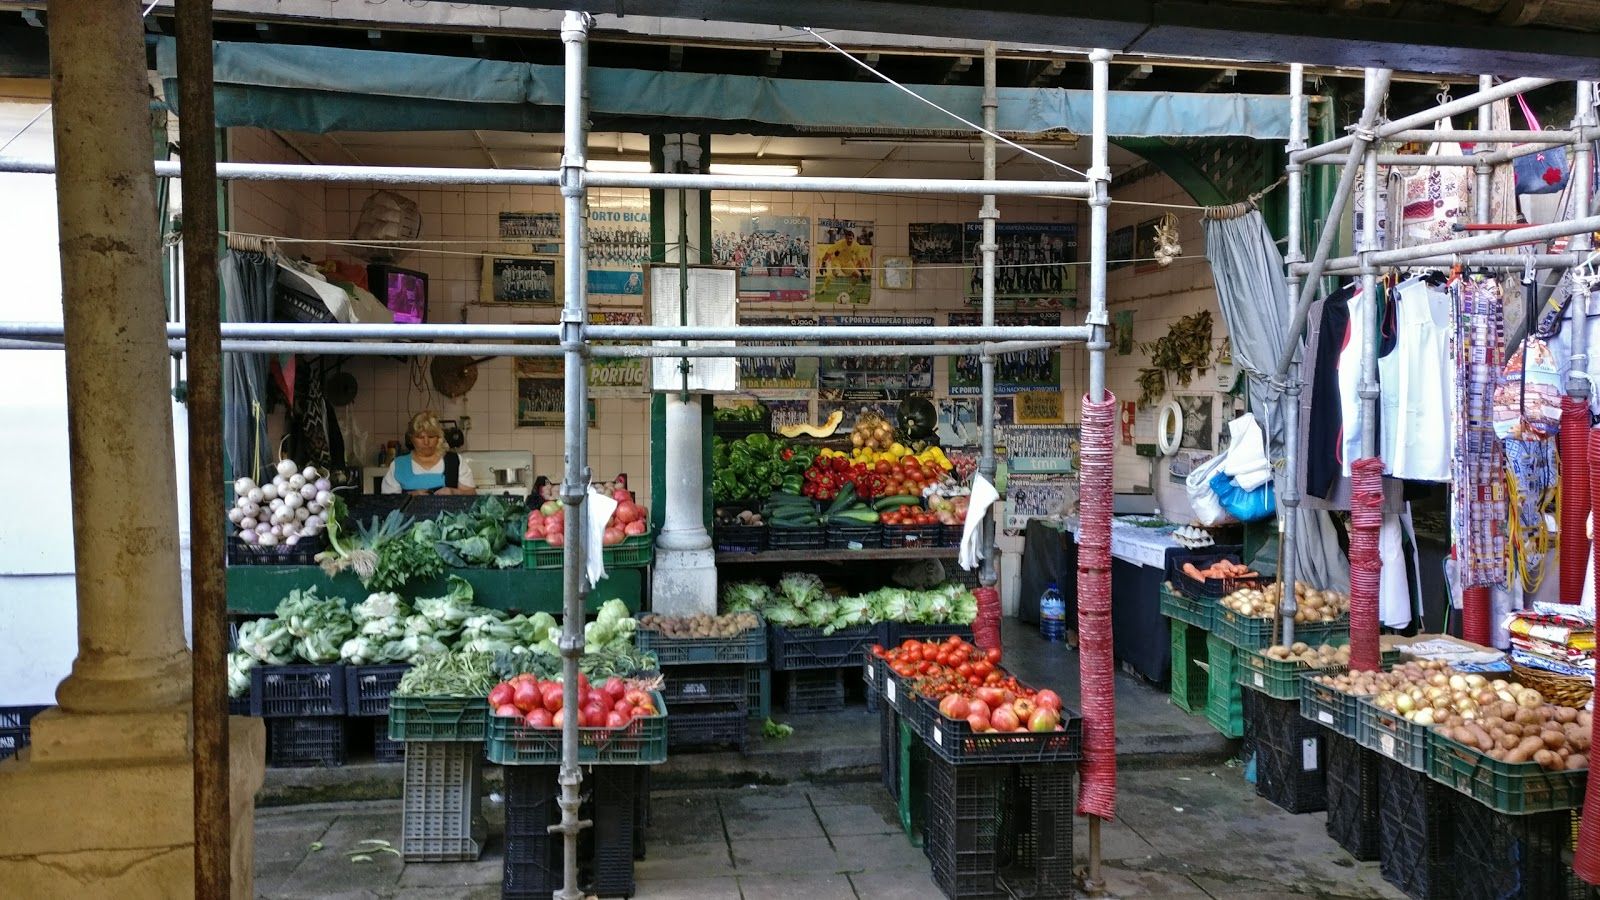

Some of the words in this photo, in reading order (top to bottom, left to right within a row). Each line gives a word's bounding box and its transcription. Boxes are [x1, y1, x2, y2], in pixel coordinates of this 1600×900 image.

[587, 211, 621, 221] ORTO
[967, 223, 974, 231] FC
[871, 316, 901, 325] CAMPEÃO
[902, 317, 932, 325] EUROPEU
[749, 380, 760, 388] DA
[761, 379, 779, 388] LIGA
[782, 379, 811, 388] EUROPA
[951, 386, 959, 394] FC
[960, 386, 980, 394] PORTO
[1031, 460, 1058, 470] tmn
